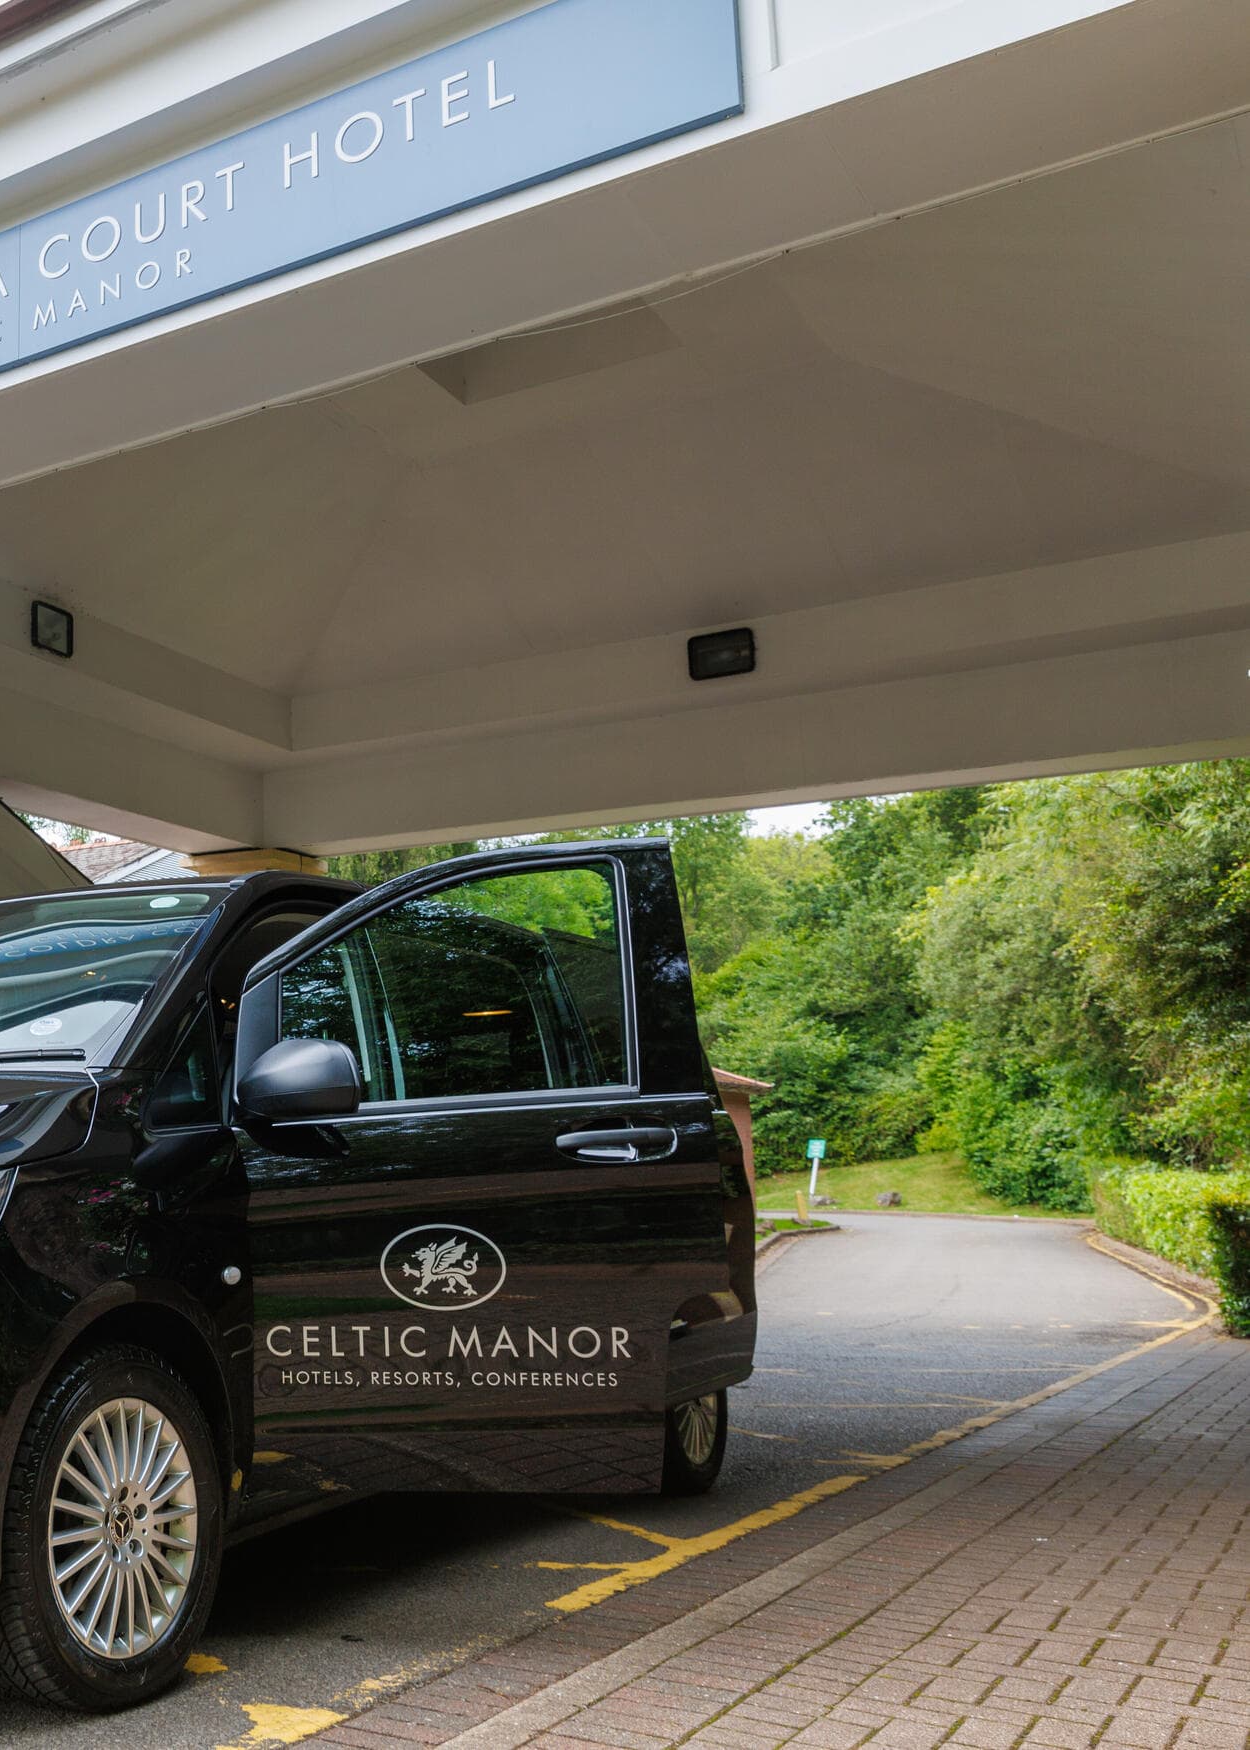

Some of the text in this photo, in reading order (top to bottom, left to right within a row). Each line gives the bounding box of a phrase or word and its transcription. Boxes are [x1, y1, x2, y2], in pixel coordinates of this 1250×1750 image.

[39, 161, 245, 279] COURT
[283, 60, 516, 190] HOTEL
[33, 248, 193, 331] MANOR
[266, 1325, 631, 1359] CELTIC MANOR
[282, 1371, 619, 1389] HOTELS, RESORTS, CONFERENCES
